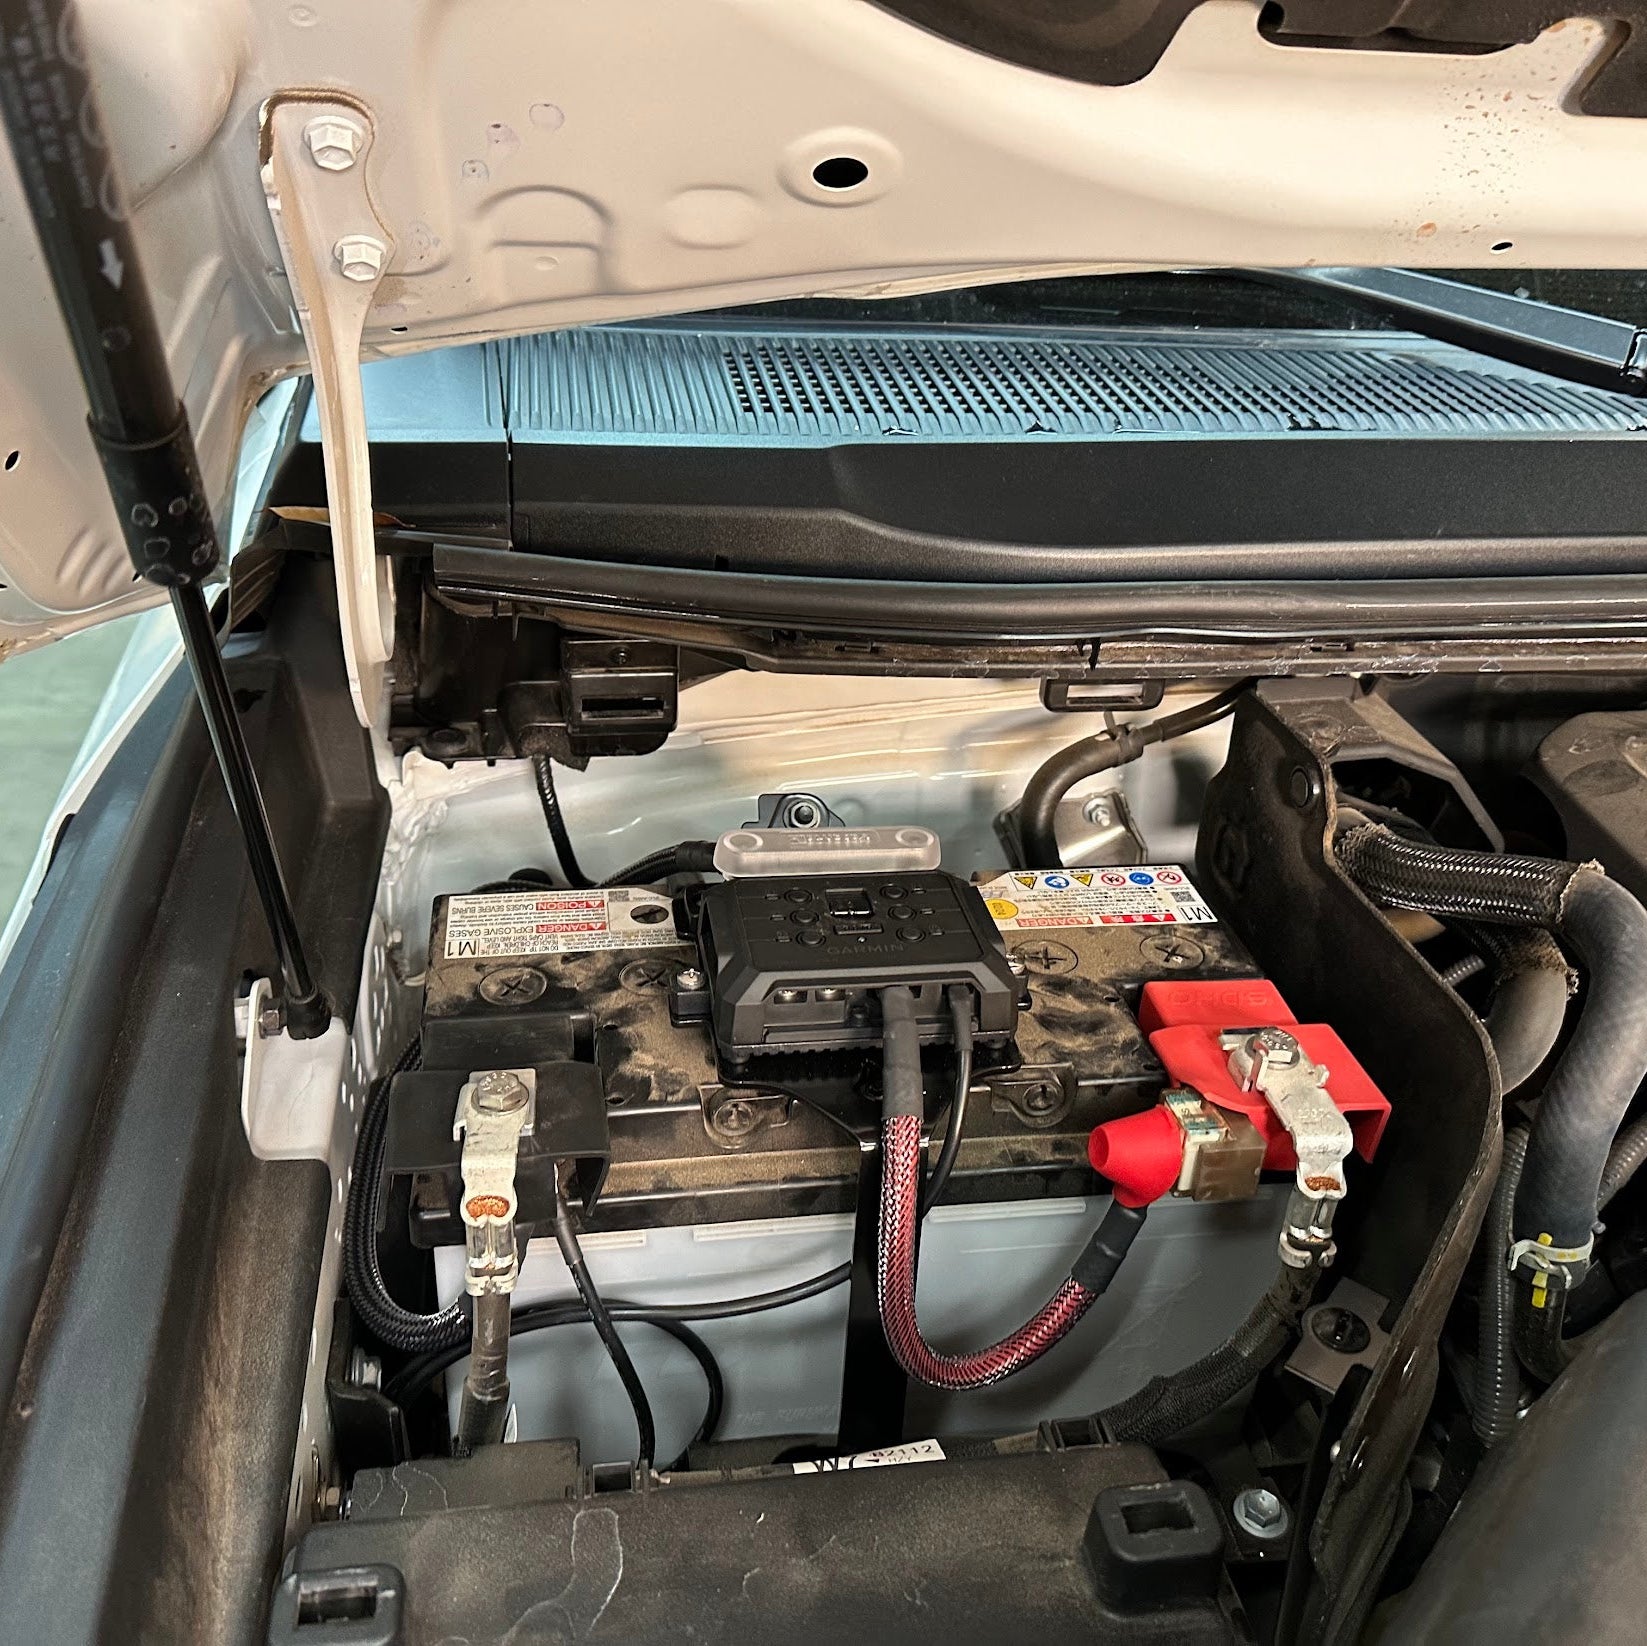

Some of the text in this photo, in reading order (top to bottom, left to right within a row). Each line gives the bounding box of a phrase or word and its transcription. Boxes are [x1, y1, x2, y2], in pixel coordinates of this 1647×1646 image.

[452, 901, 586, 915] POISON CAUSES SEVERE BURNS
[1180, 906, 1213, 921] M1
[1018, 917, 1078, 927] DANGER
[449, 923, 588, 938] DANGER EXPLOSIVE GASES
[447, 941, 477, 957] M1
[827, 944, 904, 955] GARMIN
